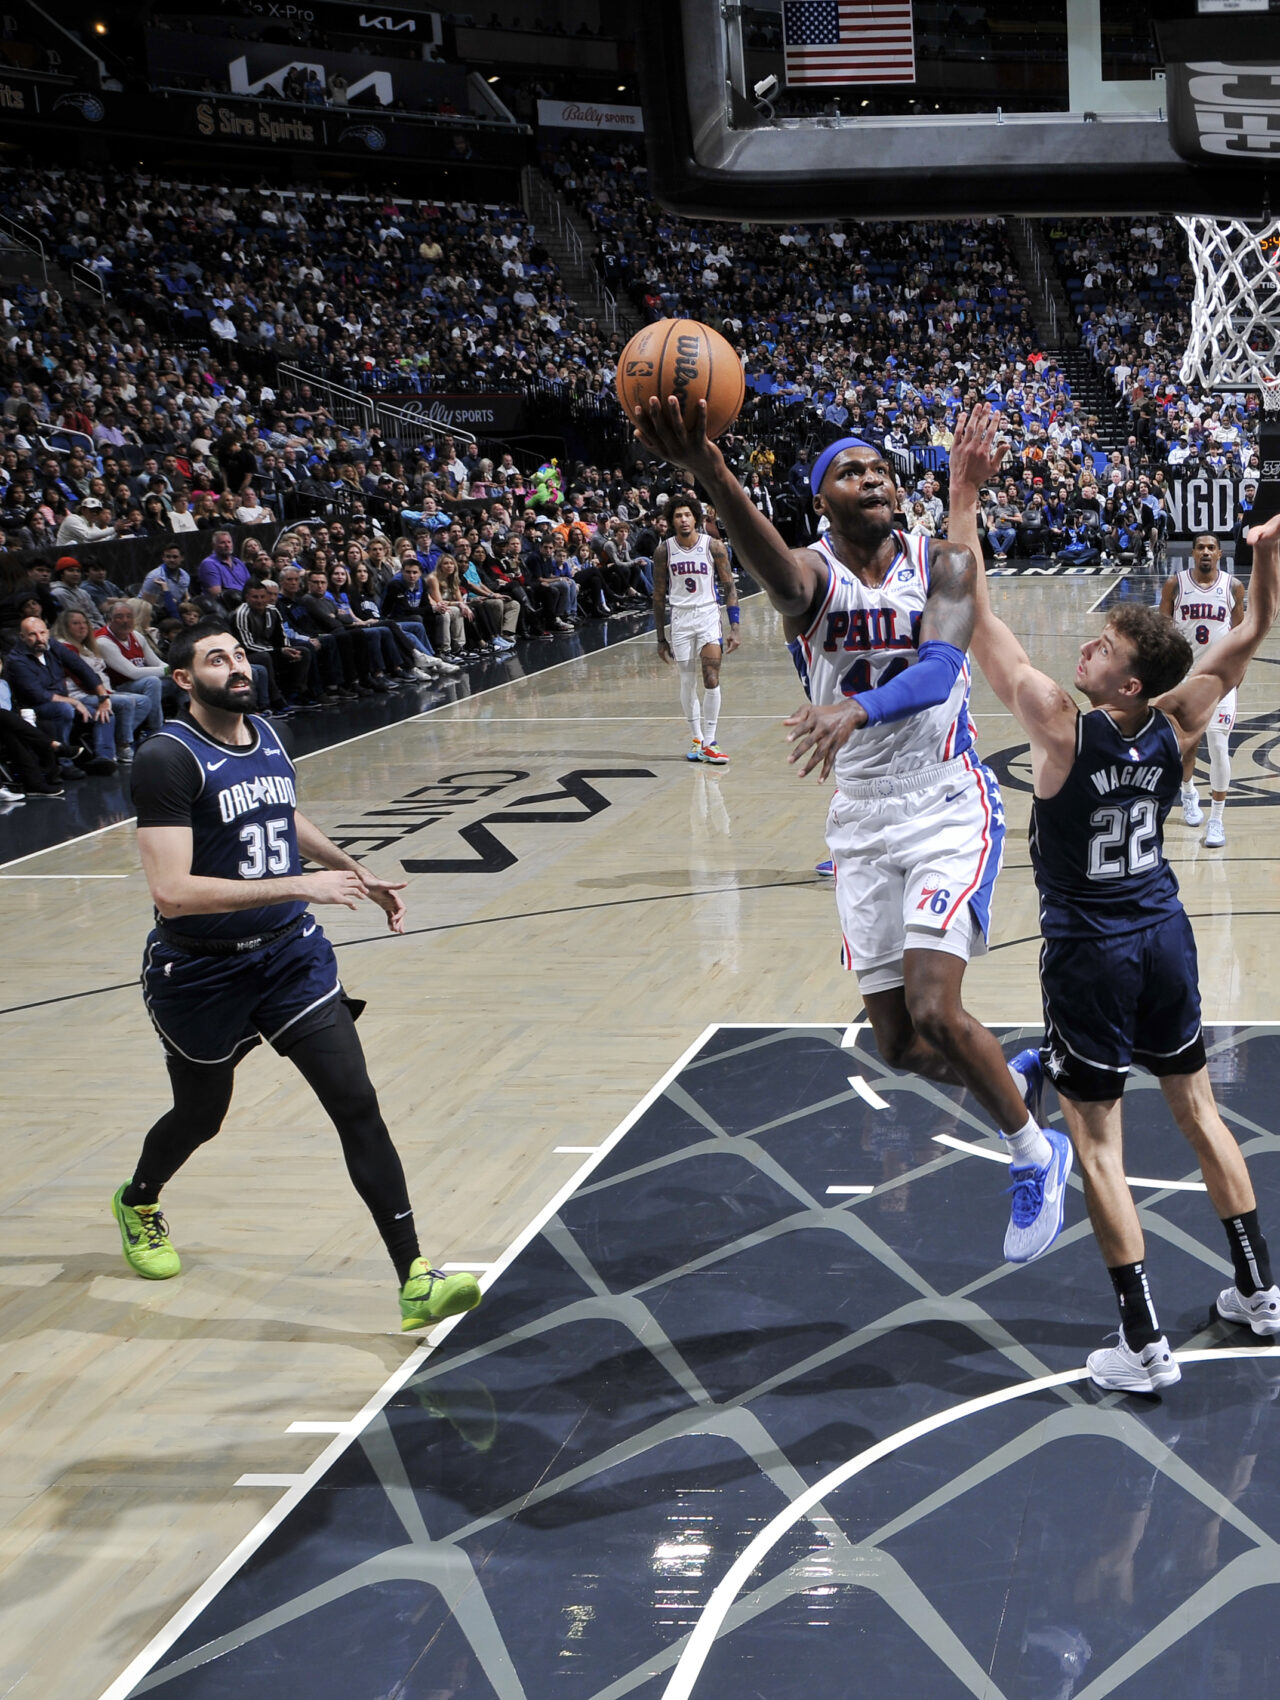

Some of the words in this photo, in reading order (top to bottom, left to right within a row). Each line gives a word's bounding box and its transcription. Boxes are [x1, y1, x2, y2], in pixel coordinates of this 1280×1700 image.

[268, 1, 315, 22] X-Pro
[218, 108, 255, 136] Sire
[258, 112, 315, 142] Spirits
[562, 104, 603, 126] Bally
[604, 115, 636, 125] SPORTS
[400, 400, 456, 429] Bally
[455, 409, 495, 423] SPORTS
[670, 561, 708, 576] PHILA
[684, 577, 697, 593] 9
[1180, 603, 1227, 622] PHILA
[1195, 624, 1210, 645] 8
[1218, 713, 1231, 725] 76
[1090, 765, 1164, 796] WAGNER
[300, 770, 530, 873] CENTE
[238, 817, 290, 879] 35
[1086, 794, 1160, 881] 22
[916, 887, 951, 914] 76
